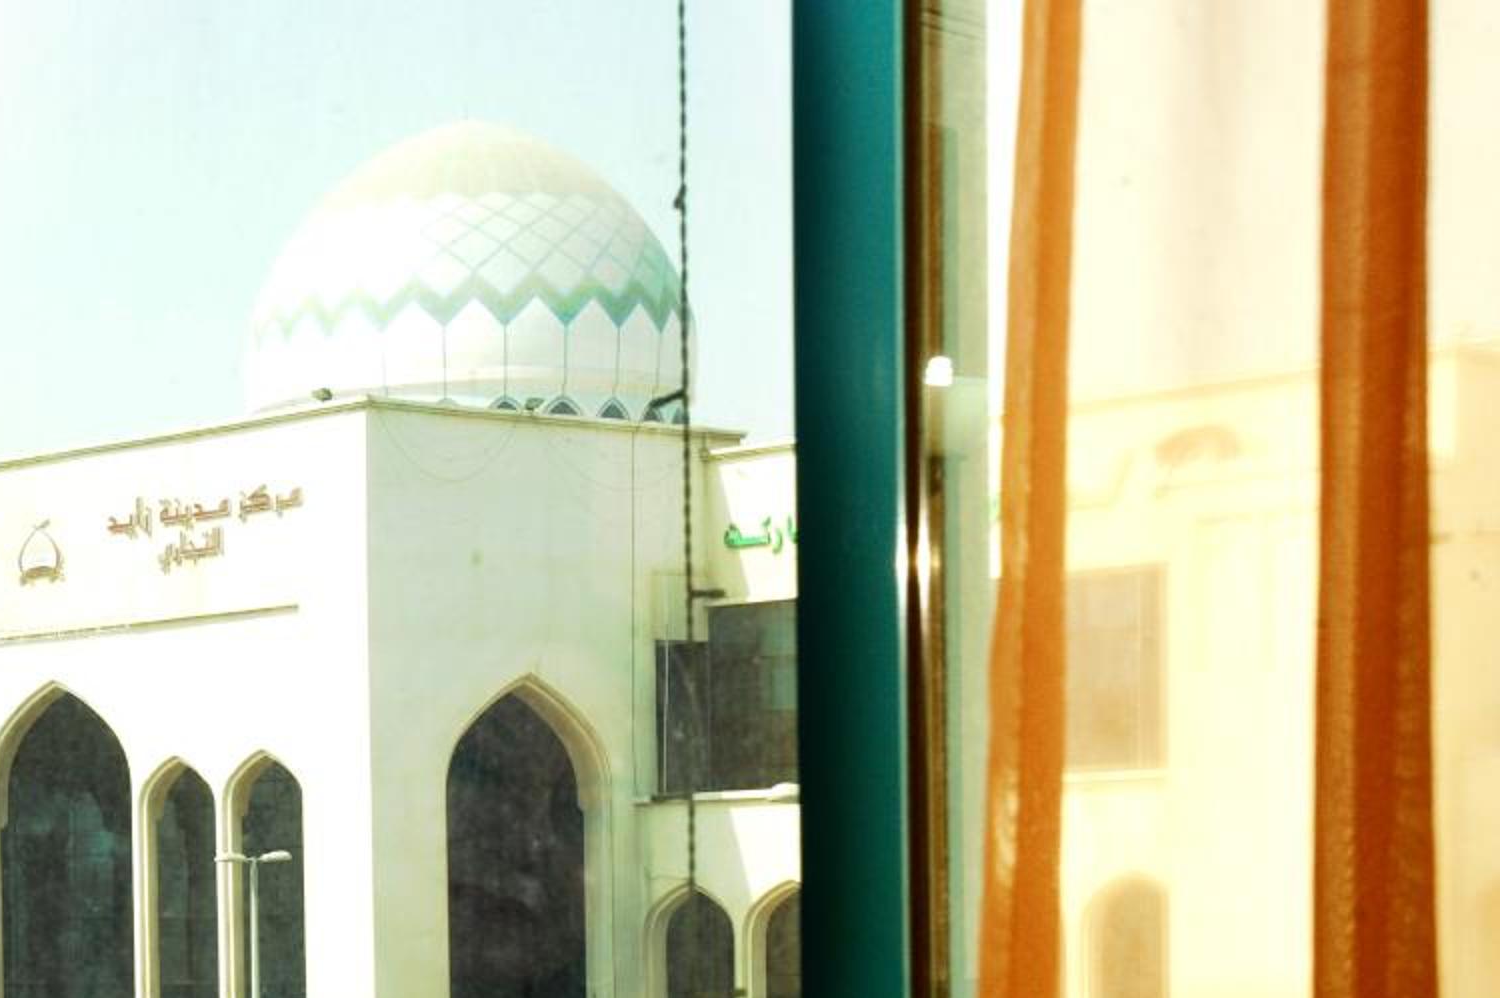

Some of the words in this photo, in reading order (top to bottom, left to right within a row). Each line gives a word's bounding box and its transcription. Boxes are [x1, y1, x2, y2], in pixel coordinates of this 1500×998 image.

[107, 496, 153, 539] زايد
[159, 498, 231, 530] مدينة
[239, 484, 302, 522] مركز
[158, 527, 224, 575] التجاري
